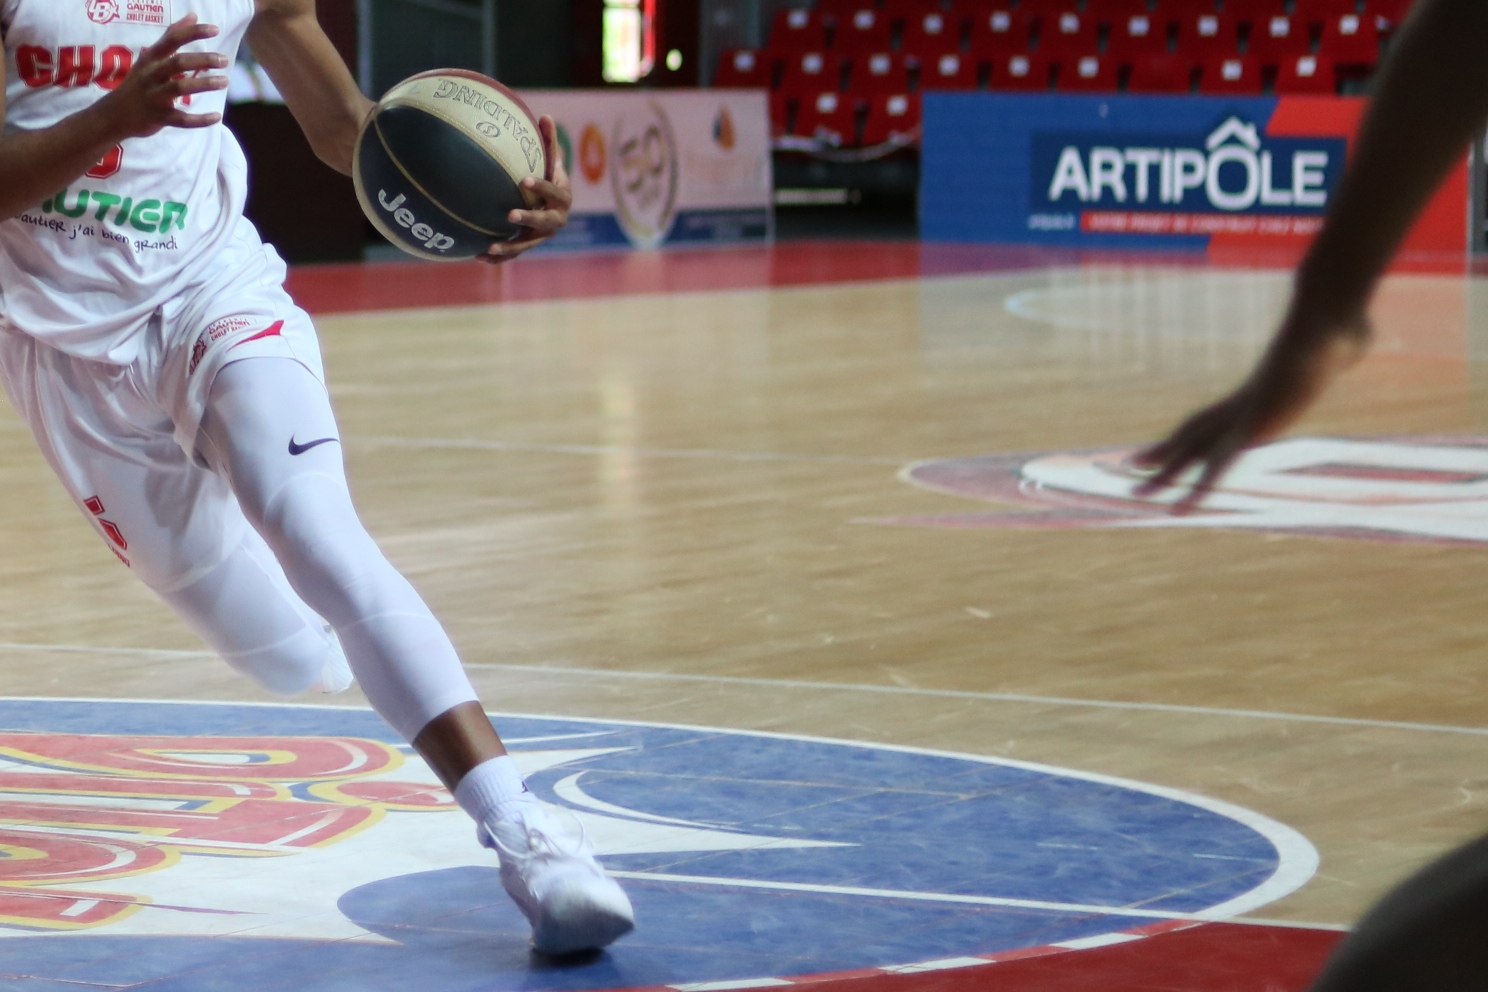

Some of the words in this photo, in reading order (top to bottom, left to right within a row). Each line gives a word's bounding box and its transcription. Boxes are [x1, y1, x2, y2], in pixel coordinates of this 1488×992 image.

[126, 12, 144, 22] CHOLET
[144, 14, 164, 24] BASKET
[433, 78, 543, 174] SPALDING
[1048, 115, 1329, 211] ARTIPÔLE
[42, 188, 189, 234] UTIER
[69, 225, 94, 240] j'ai
[102, 229, 129, 245] bien
[378, 188, 455, 251] Jeep
